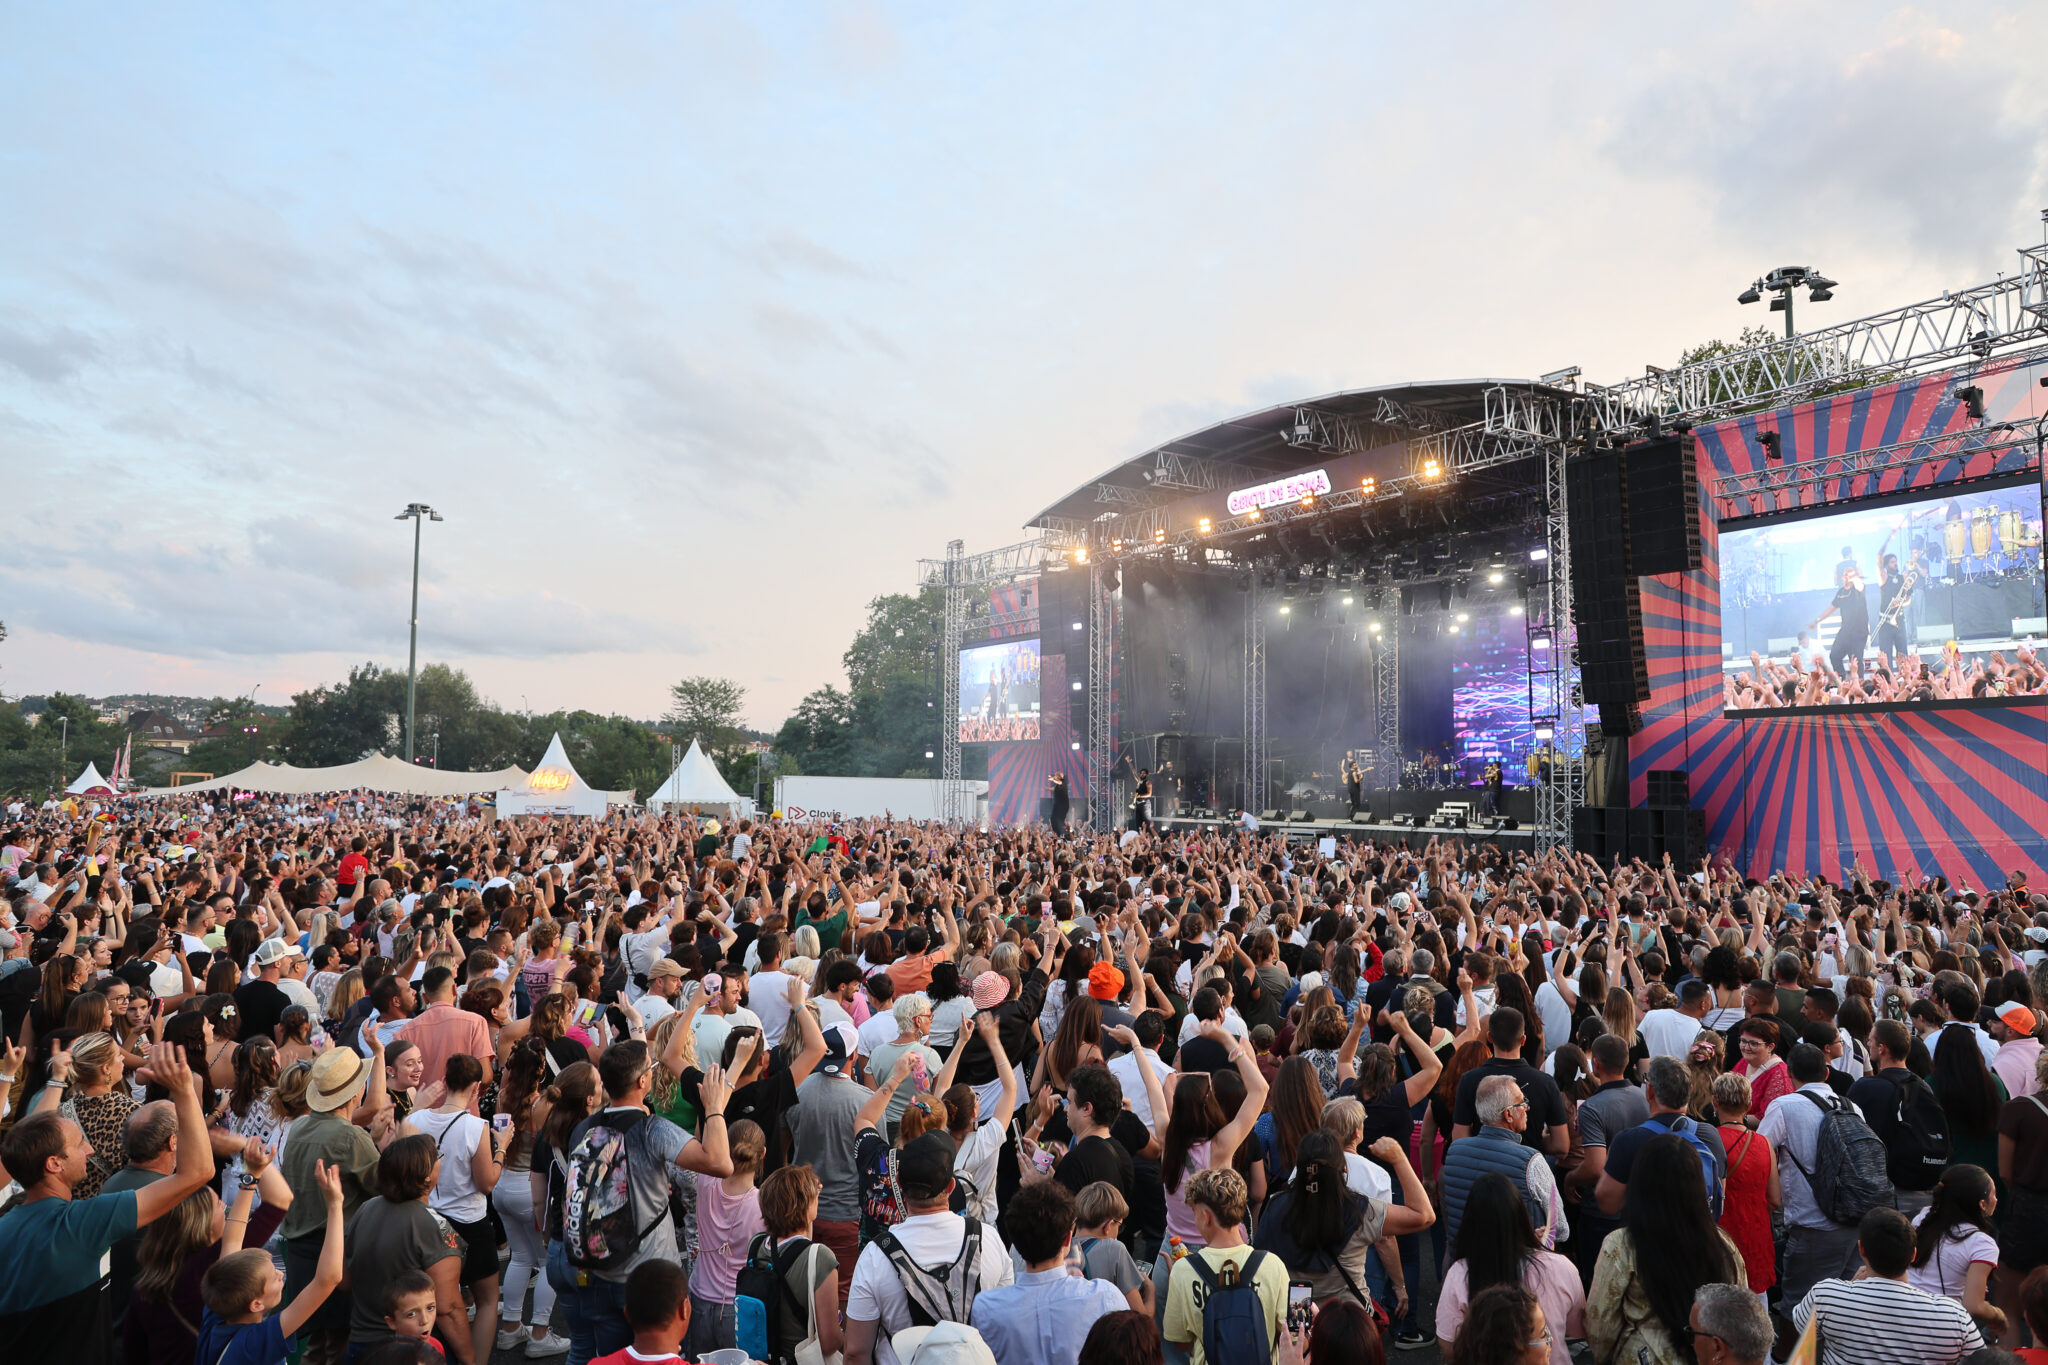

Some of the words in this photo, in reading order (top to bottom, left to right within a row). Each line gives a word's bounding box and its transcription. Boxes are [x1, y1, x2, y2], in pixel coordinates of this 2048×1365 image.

[1231, 490, 1266, 511] GENTE
[1269, 485, 1284, 502] DE
[1287, 474, 1327, 498] ZONA
[809, 809, 841, 818] Clovis
[567, 1189, 585, 1259] adidas
